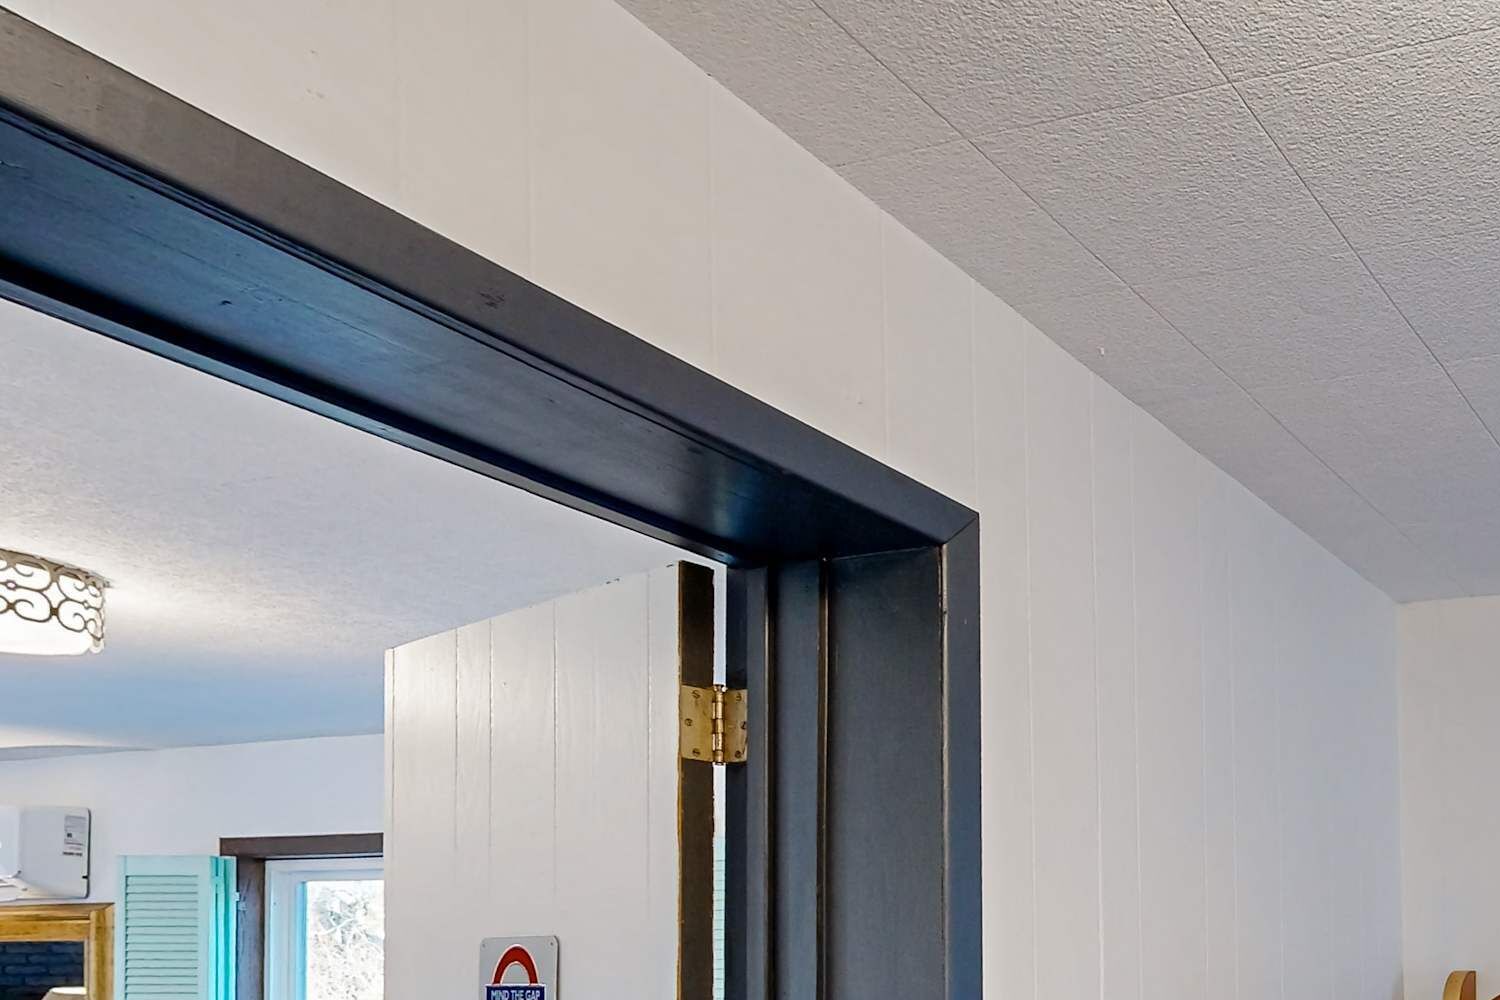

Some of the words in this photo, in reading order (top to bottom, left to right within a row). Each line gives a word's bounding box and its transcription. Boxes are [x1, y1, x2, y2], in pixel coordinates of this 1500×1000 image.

[490, 990, 509, 1000] MIND
[510, 990, 524, 1000] THE
[525, 989, 541, 1000] GAP
